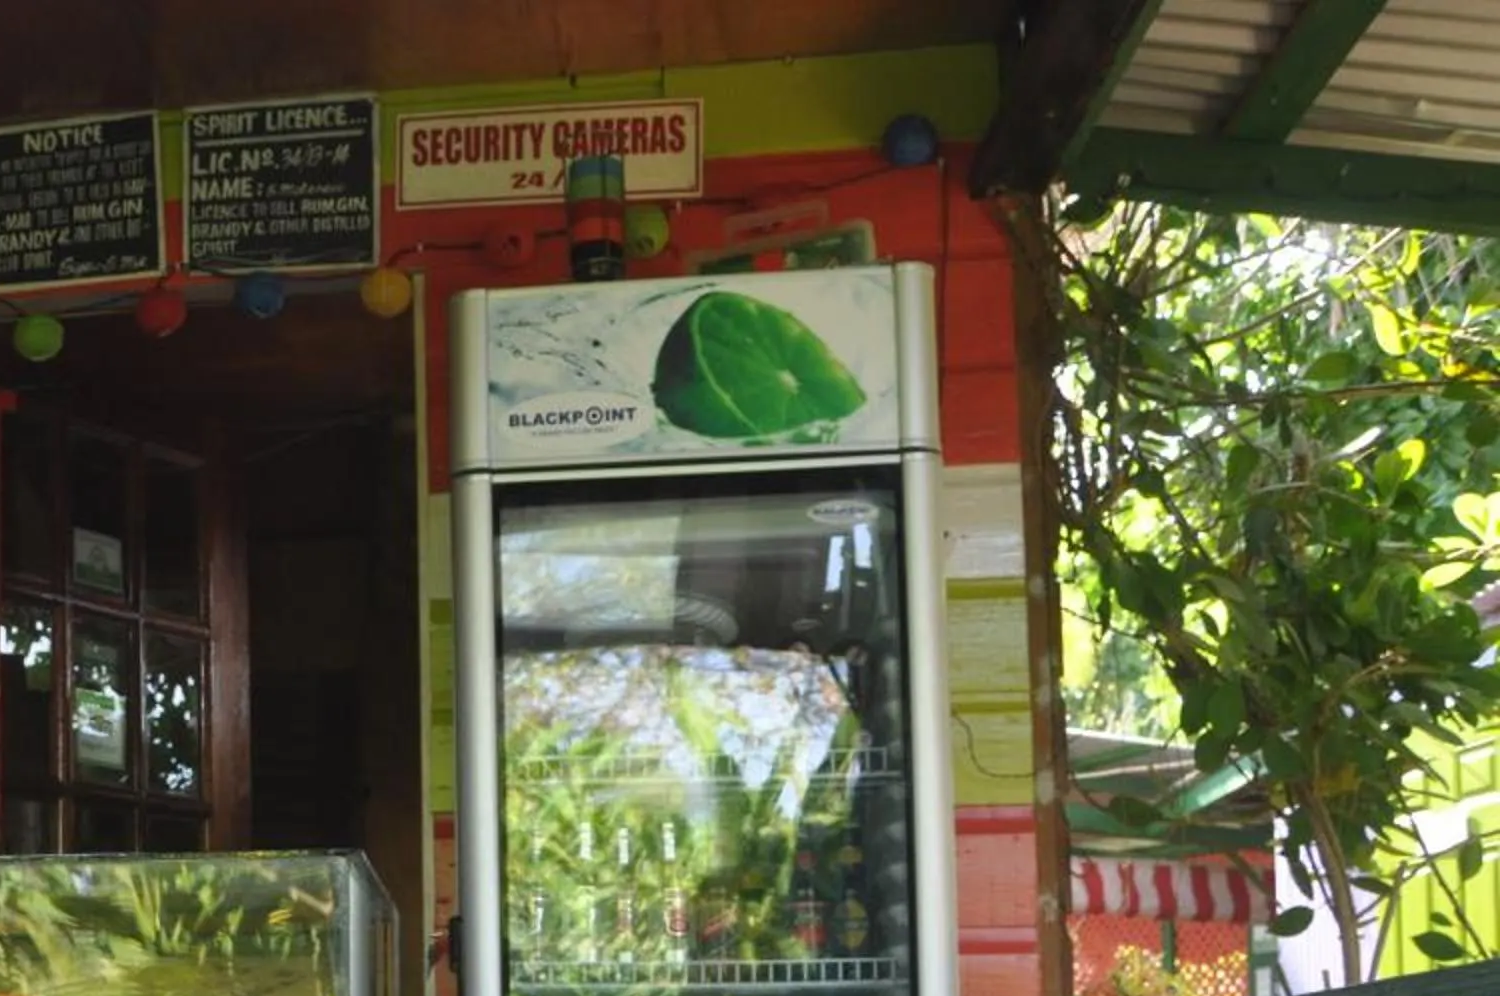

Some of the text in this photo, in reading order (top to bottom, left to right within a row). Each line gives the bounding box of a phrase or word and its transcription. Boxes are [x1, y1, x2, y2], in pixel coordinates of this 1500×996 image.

[22, 124, 105, 154] NOTICE
[411, 113, 686, 168] SECURITY CAMERAS
[192, 221, 251, 240] BRANDY
[508, 405, 638, 428] BLACKPOINT
